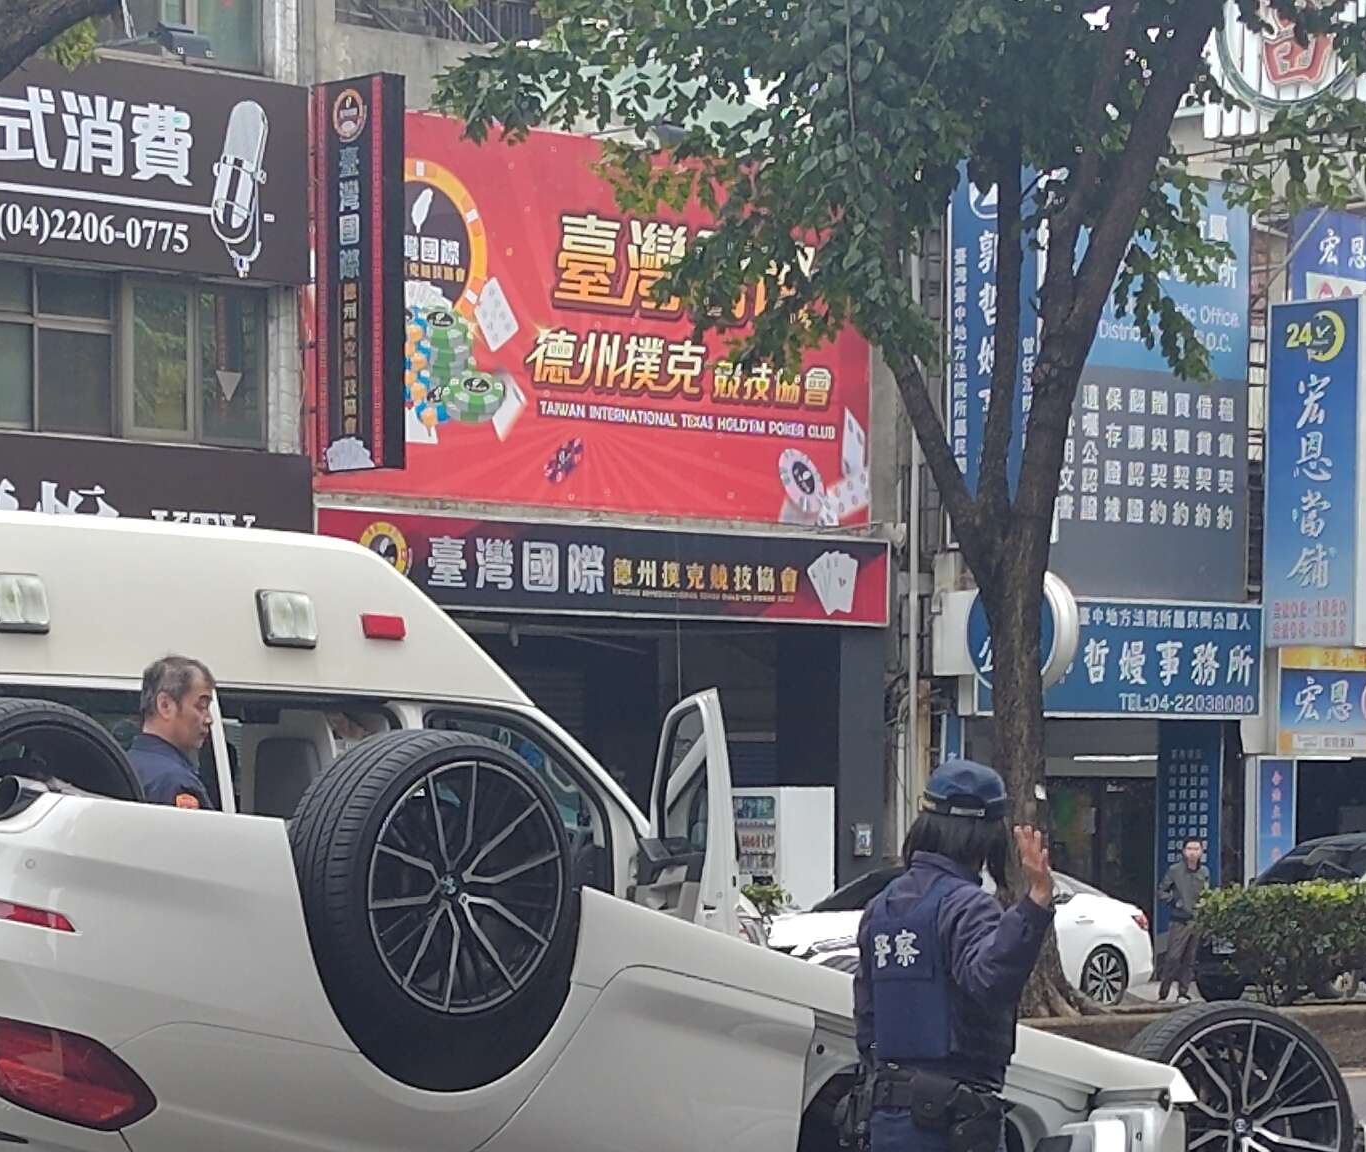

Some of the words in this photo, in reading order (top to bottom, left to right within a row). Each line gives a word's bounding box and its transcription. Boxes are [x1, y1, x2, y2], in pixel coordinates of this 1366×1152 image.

[1286, 321, 1313, 349] 24
[539, 400, 586, 418] TAIWAN
[426, 534, 607, 596] 臺灣國際
[1294, 676, 1352, 724] 宏恩
[874, 928, 921, 968] 警察
